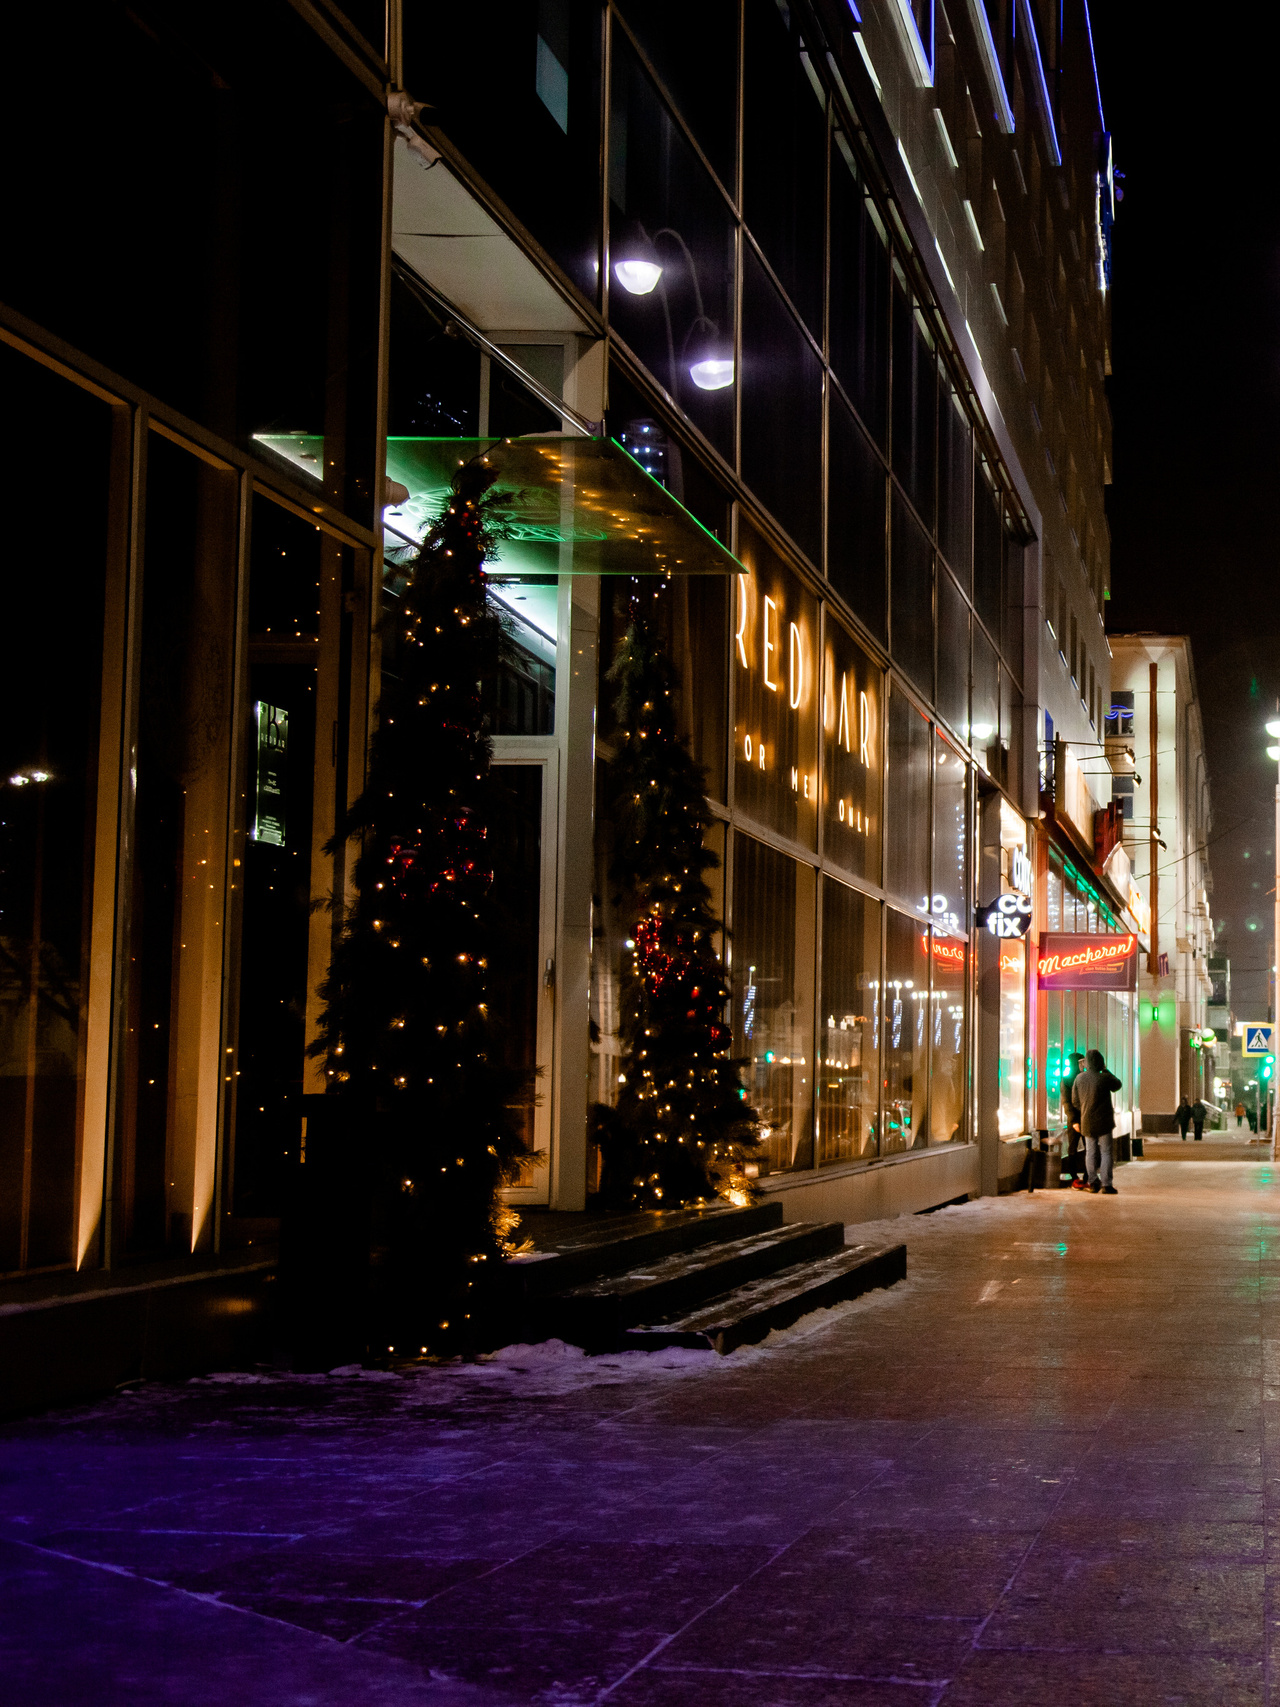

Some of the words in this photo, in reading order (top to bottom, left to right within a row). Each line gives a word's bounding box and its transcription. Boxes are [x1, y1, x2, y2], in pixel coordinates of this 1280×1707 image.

[735, 573, 803, 710] RED
[823, 671, 870, 769] AR
[791, 765, 810, 799] ME
[838, 798, 870, 837] ONLY
[987, 911, 1022, 937] fix
